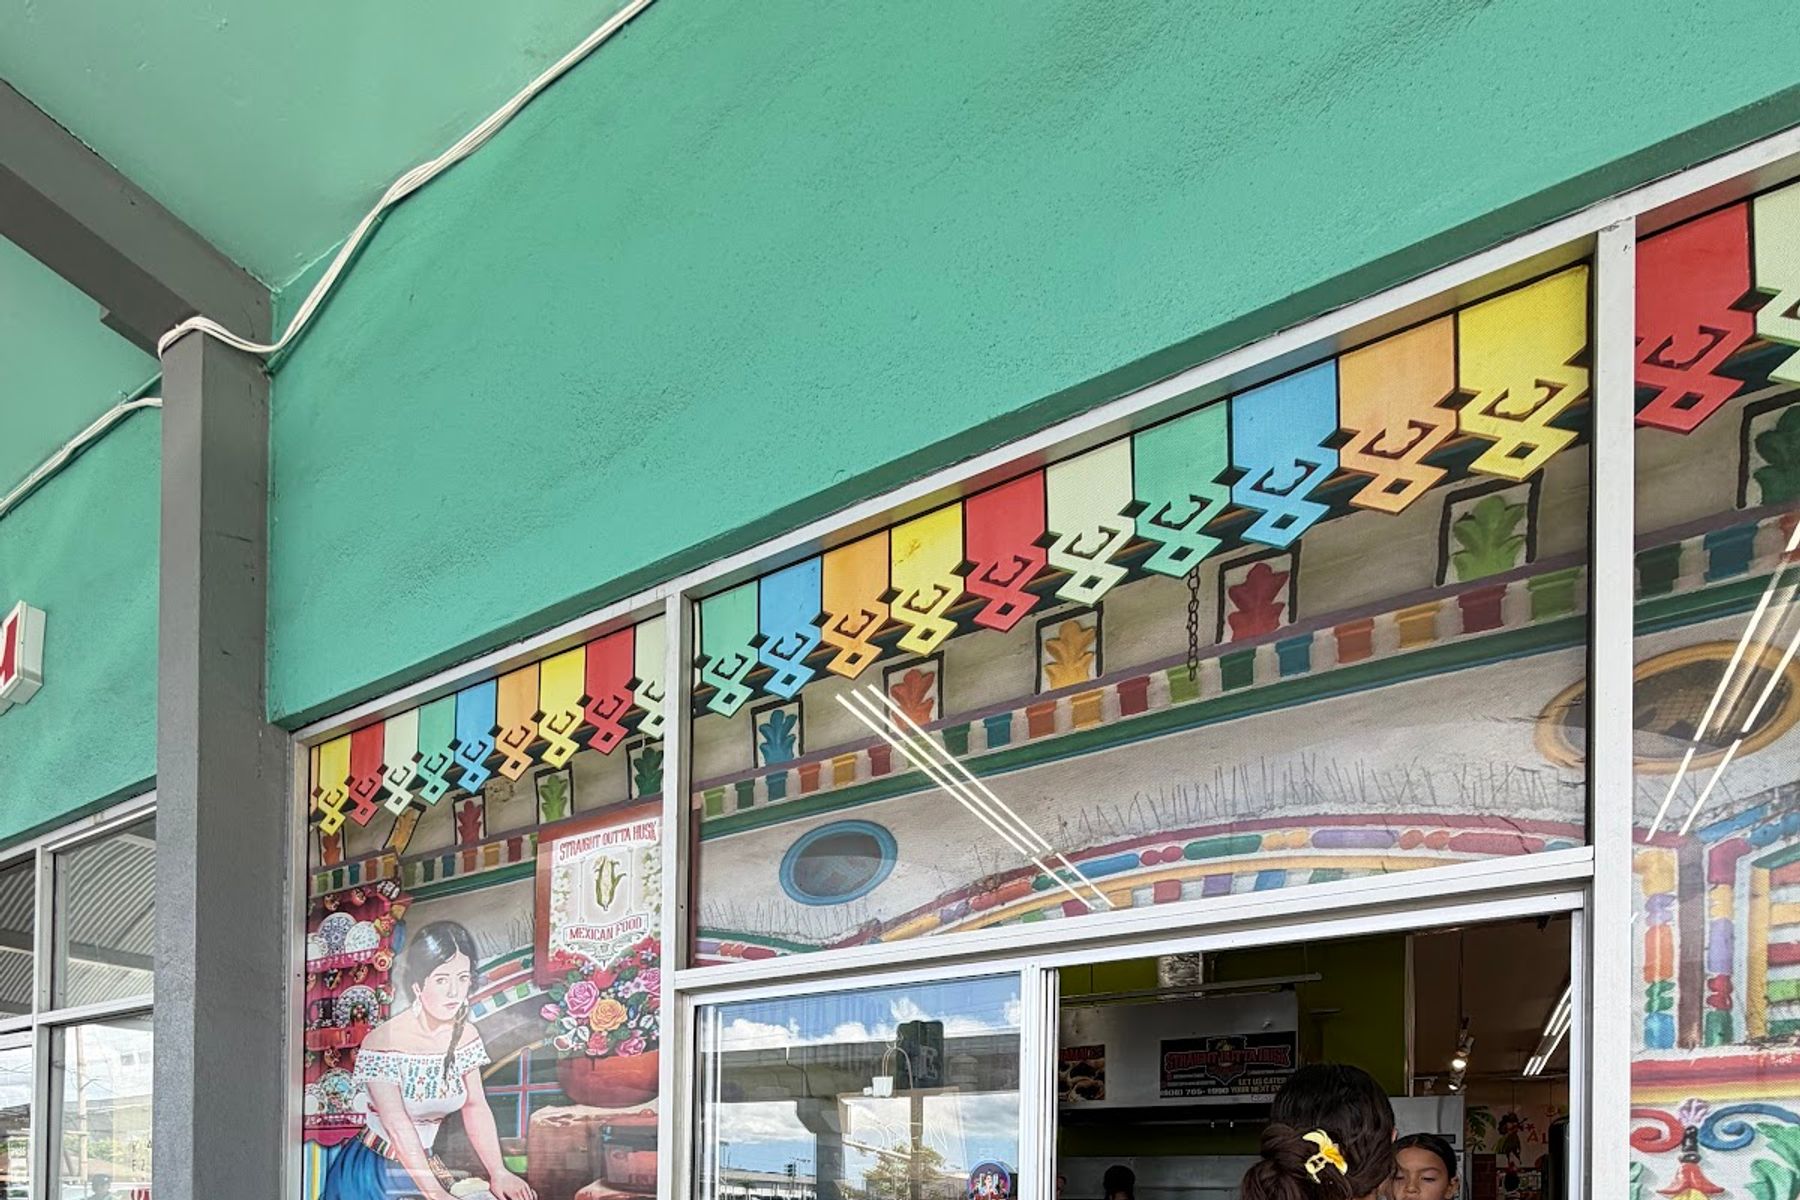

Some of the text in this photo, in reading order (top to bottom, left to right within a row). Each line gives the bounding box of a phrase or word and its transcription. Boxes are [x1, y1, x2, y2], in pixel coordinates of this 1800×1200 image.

[603, 827, 632, 846] OUTTA
[569, 917, 642, 940] MEXICAN FOOD
